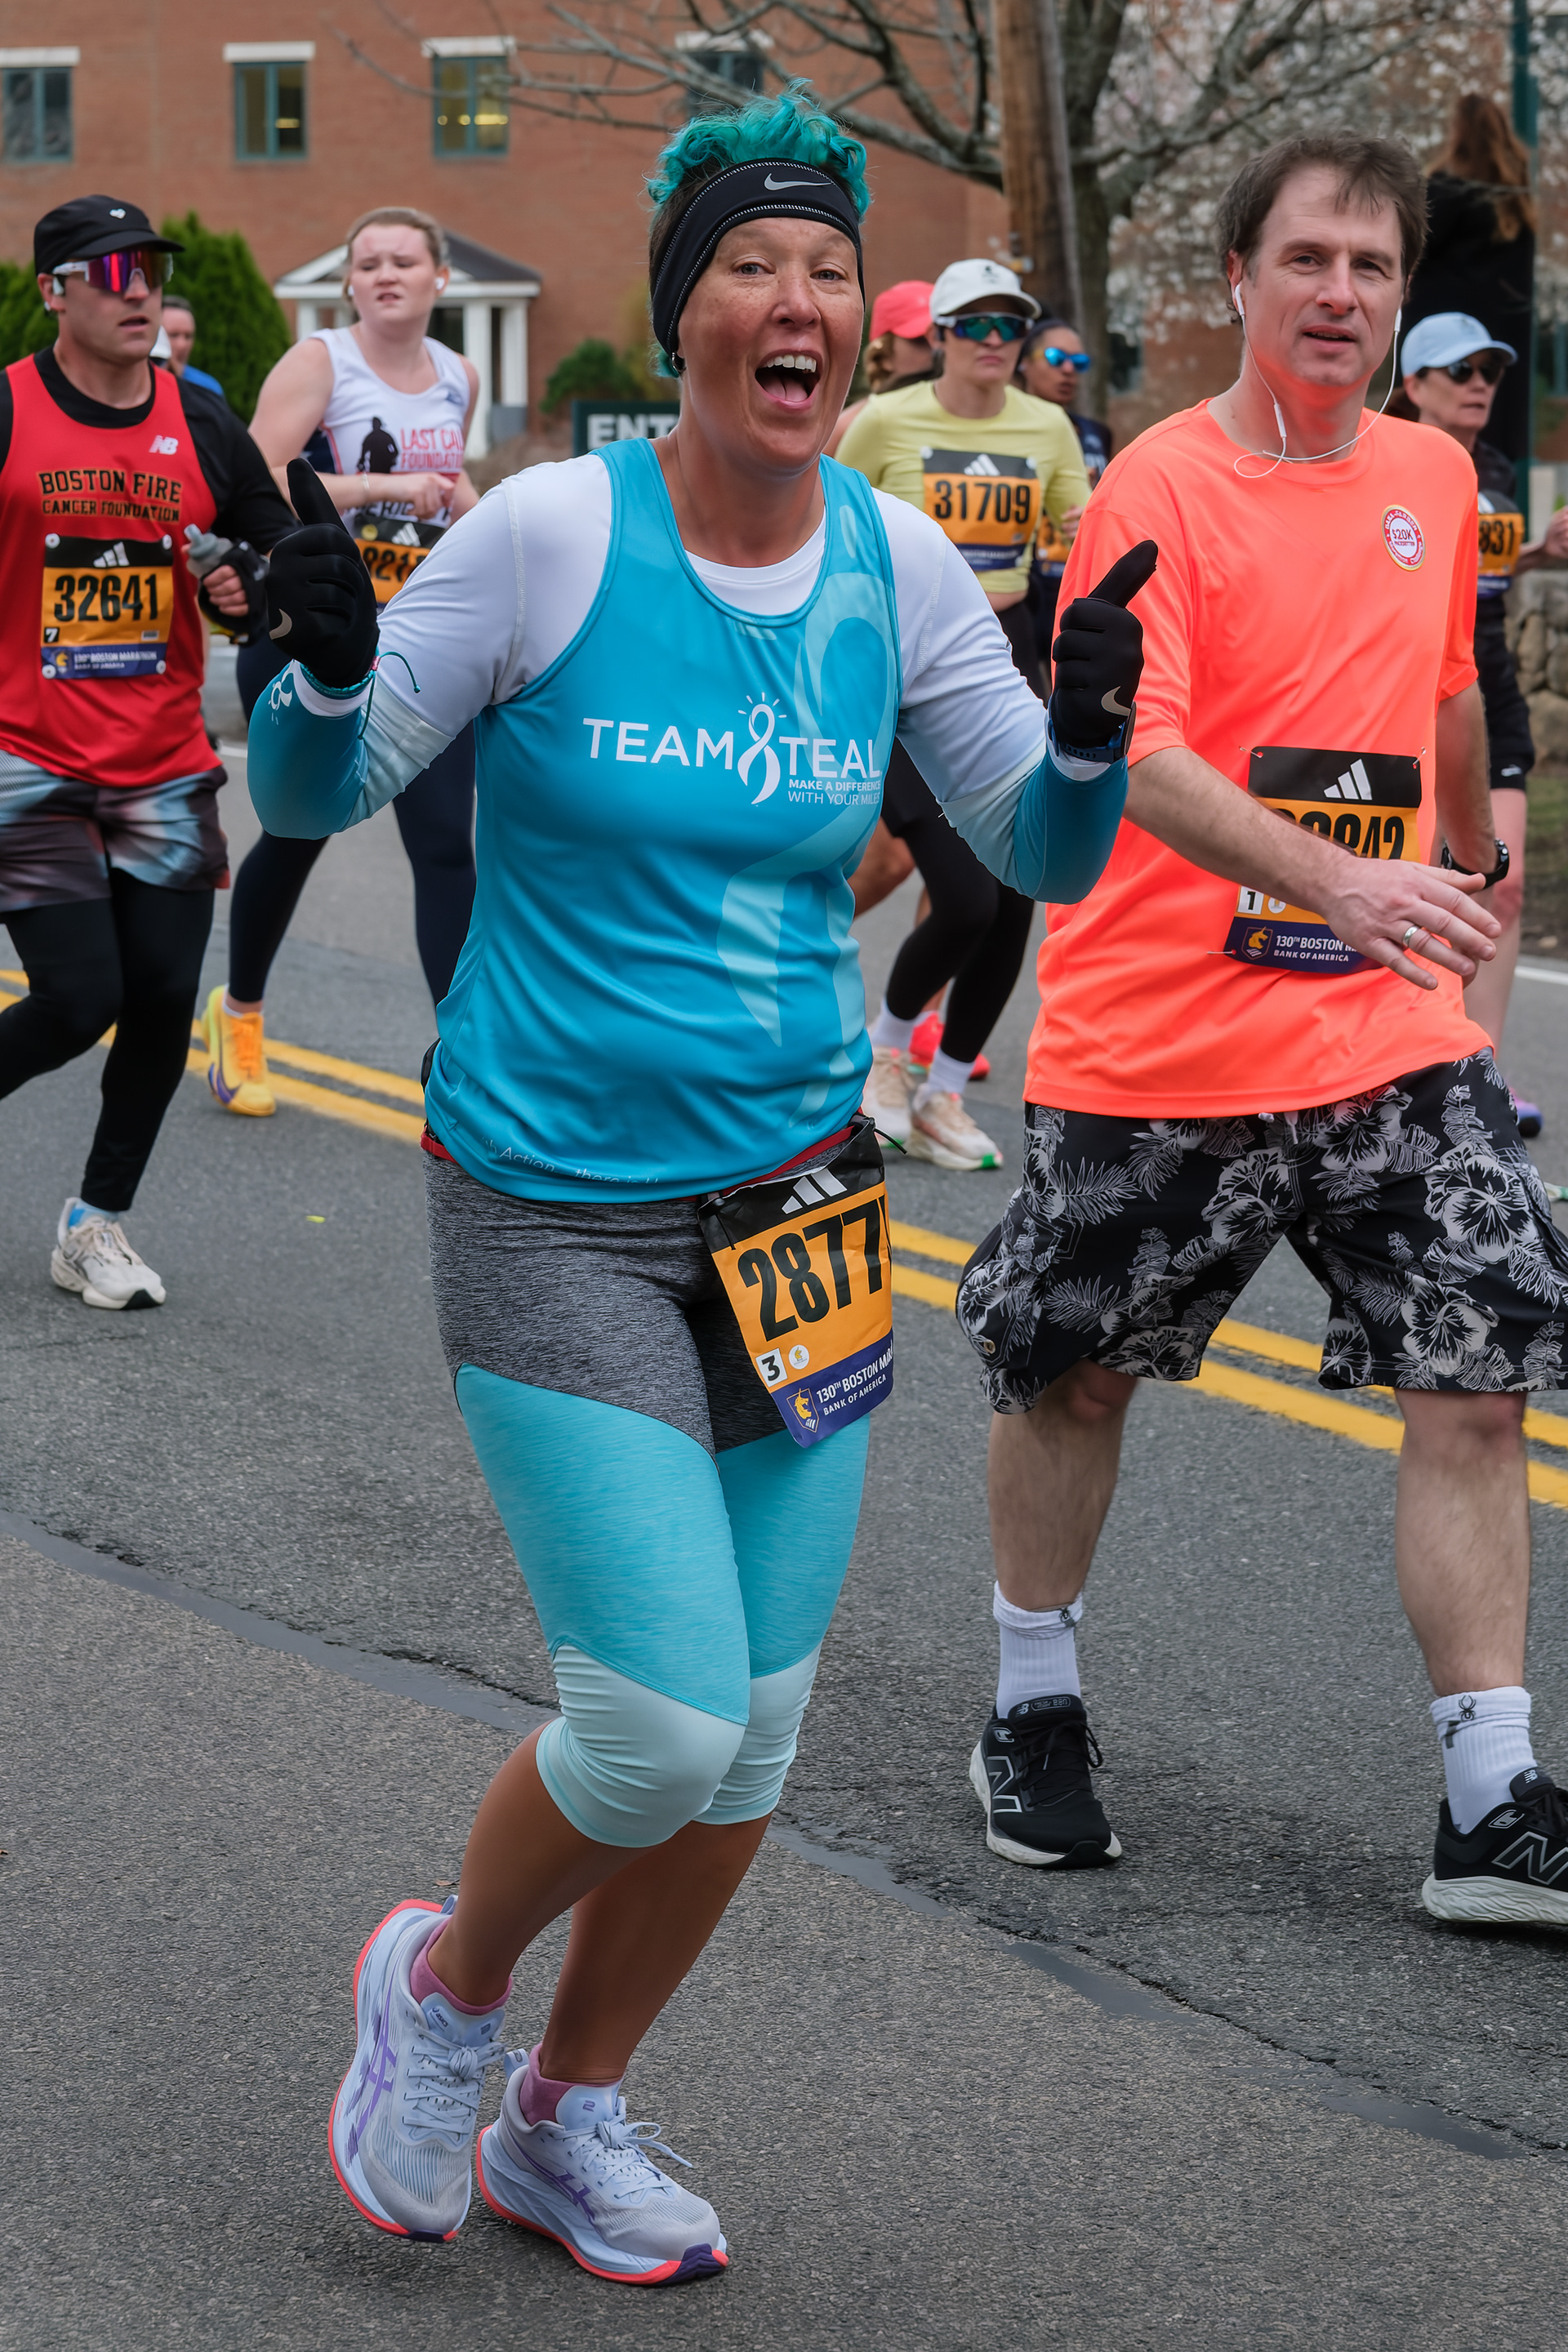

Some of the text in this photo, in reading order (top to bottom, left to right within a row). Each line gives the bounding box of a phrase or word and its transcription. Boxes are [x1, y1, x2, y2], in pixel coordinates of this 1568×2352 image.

[400, 428, 436, 450] LAST
[587, 413, 679, 450] ENT
[38, 468, 183, 504] BOSTON FIRE
[42, 499, 180, 523] CANCER FOUNDATION
[934, 479, 1031, 524] 31709
[1392, 528, 1414, 541] $20K
[53, 573, 158, 622] 32641
[46, 628, 59, 643] 7
[582, 717, 881, 779] TEAM TEAL
[788, 791, 823, 804] WITH
[827, 793, 859, 806] YOUR
[789, 778, 881, 792] MAKE A DIFFERENCE
[1273, 949, 1349, 962] BANK OF AMERICA
[1276, 935, 1300, 948] 130TH
[1300, 937, 1343, 951] BOSTON
[737, 1193, 892, 1342] 2877
[760, 1355, 782, 1383] 3
[816, 1381, 842, 1404] 130TH
[841, 1361, 879, 1392] BOSTON
[823, 1374, 887, 1416] BANK OF AMERICA
